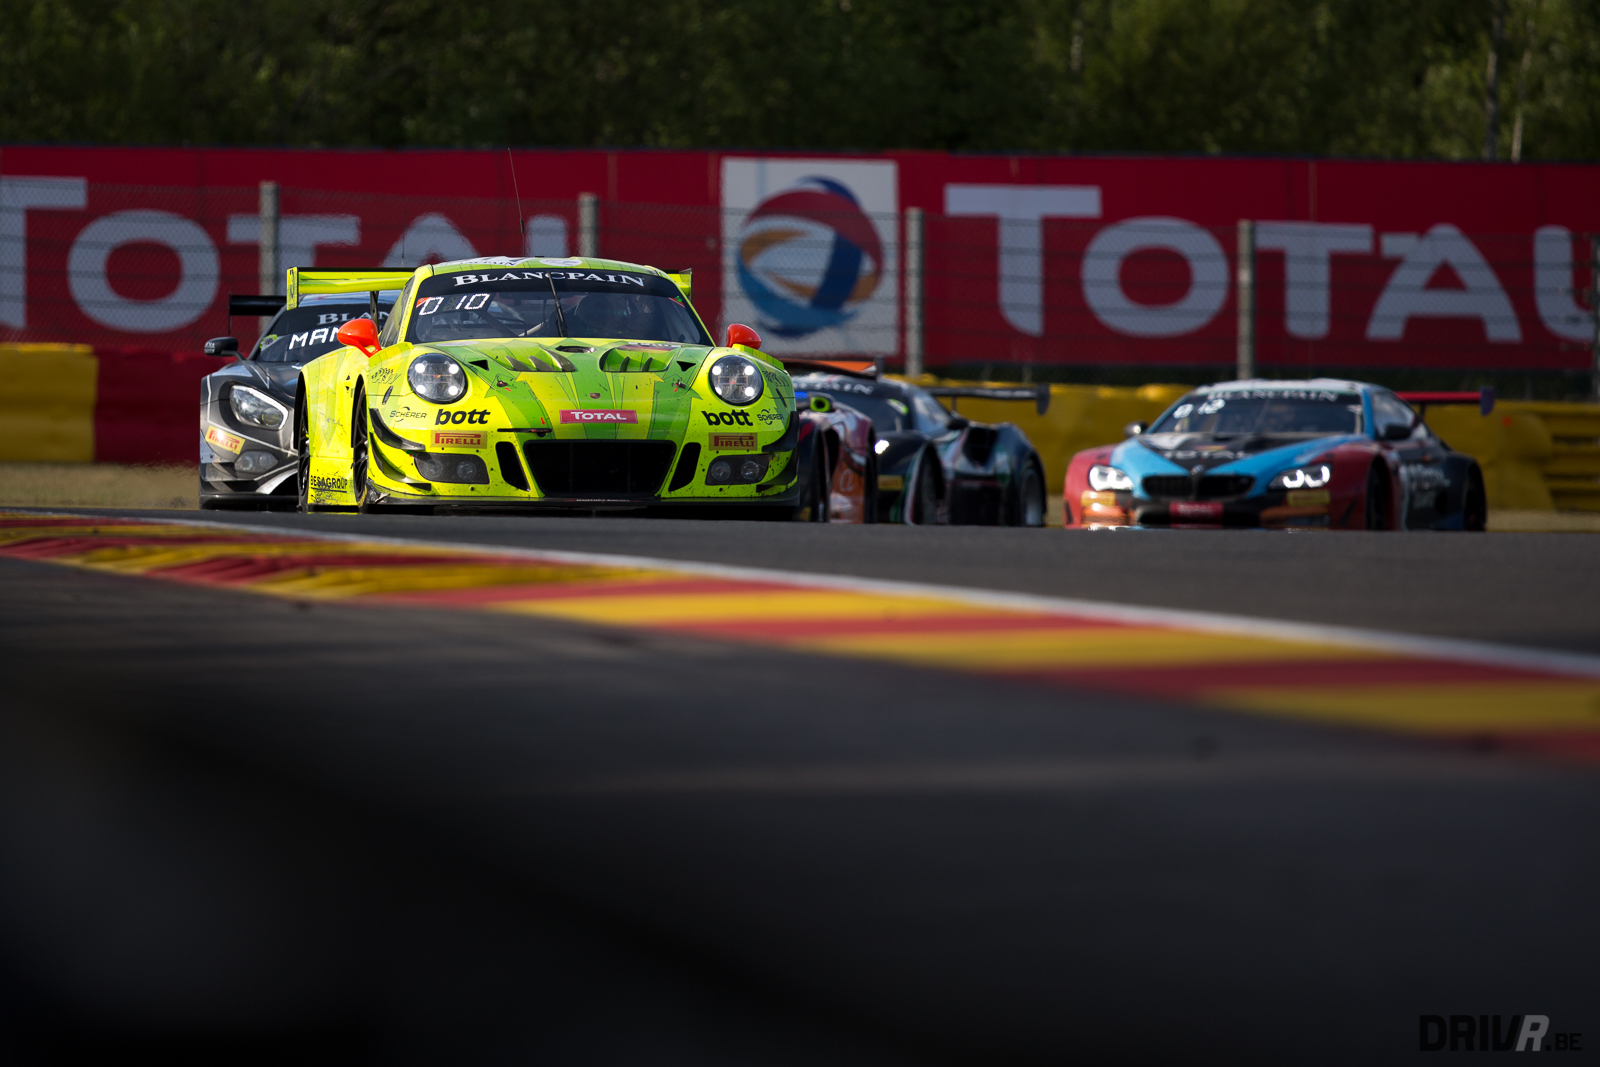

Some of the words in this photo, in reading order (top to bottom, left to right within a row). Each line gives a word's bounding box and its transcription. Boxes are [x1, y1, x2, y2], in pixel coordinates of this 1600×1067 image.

[944, 183, 1598, 343] TOTAL
[452, 271, 645, 287] BLANCPAIN
[390, 409, 428, 420] SCHERER
[435, 409, 491, 426] bott
[570, 411, 627, 421] TOTAL
[701, 409, 753, 427] bott
[209, 429, 240, 450] PIRELLI
[435, 432, 482, 446] PIRELLI
[714, 435, 755, 448] PIRELLI
